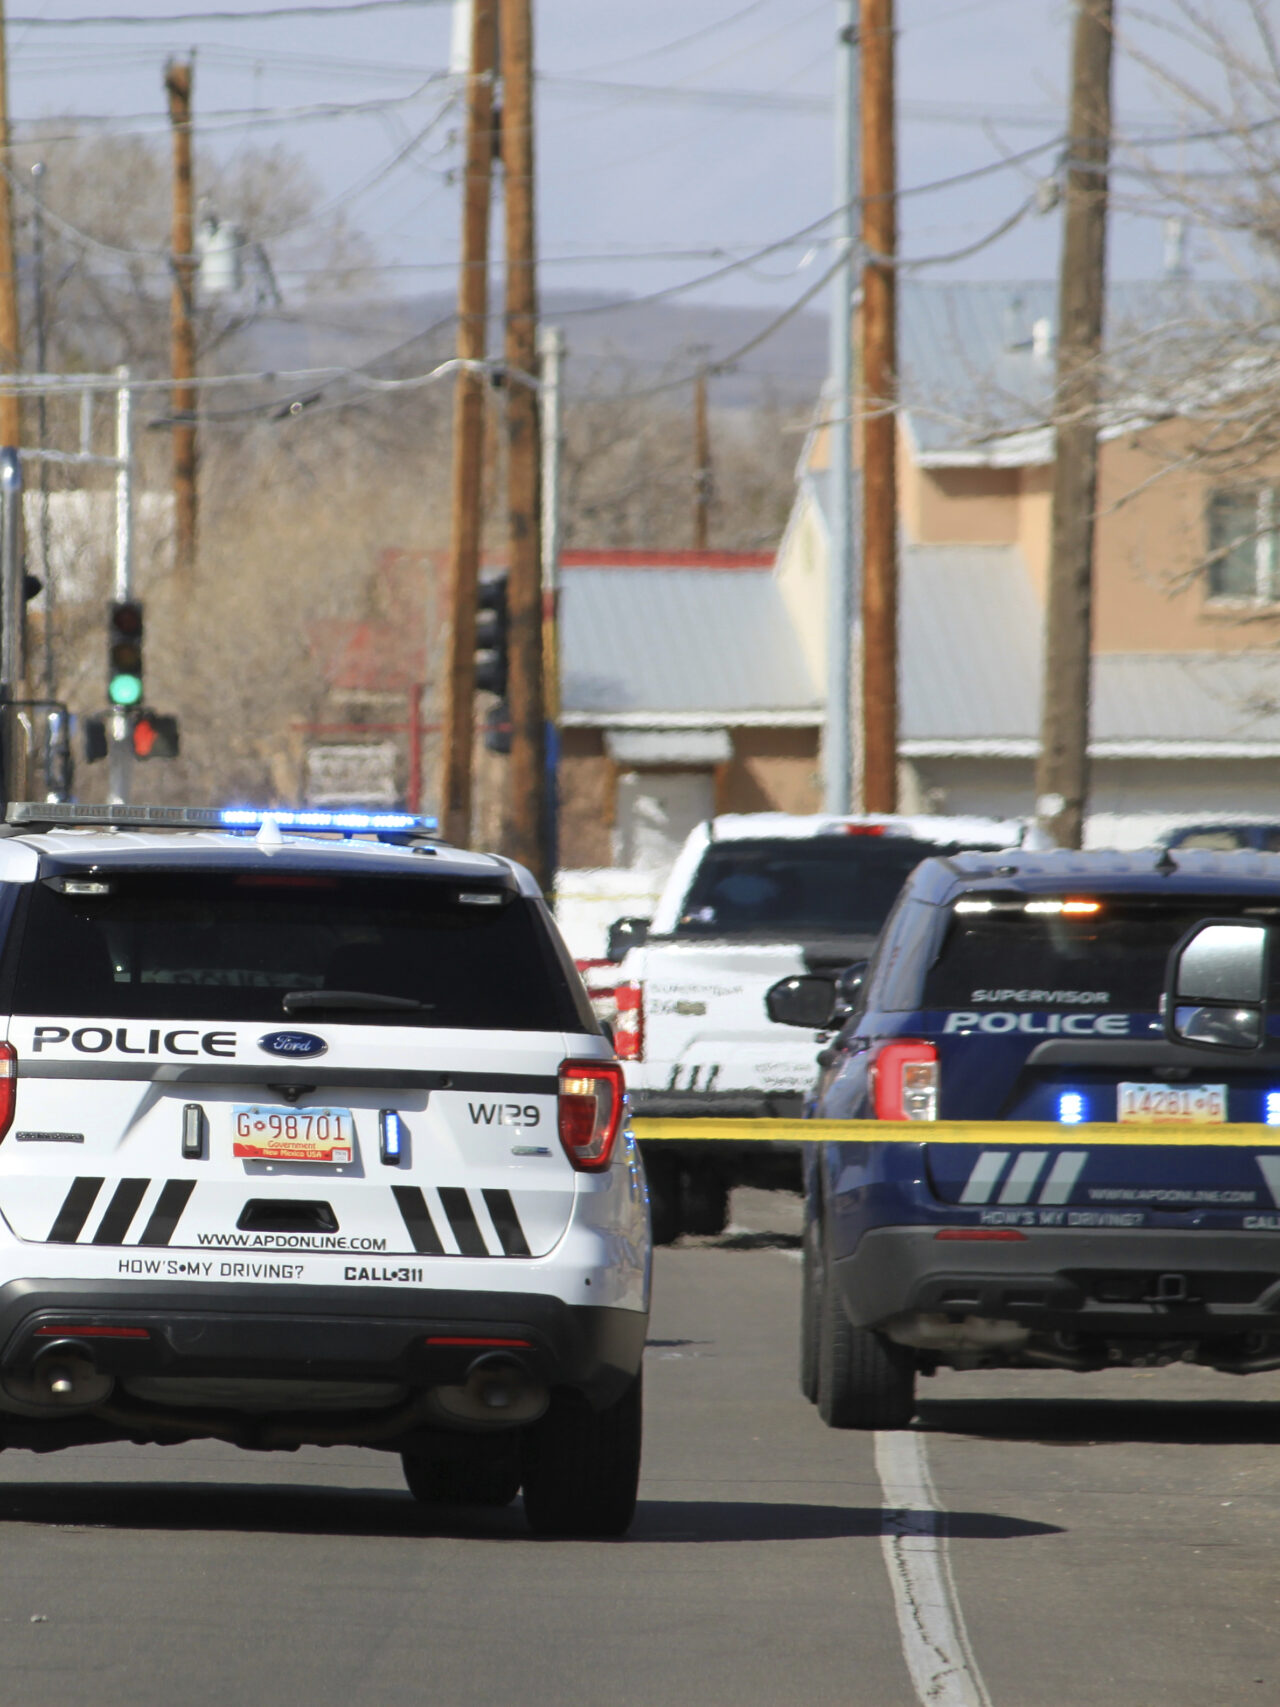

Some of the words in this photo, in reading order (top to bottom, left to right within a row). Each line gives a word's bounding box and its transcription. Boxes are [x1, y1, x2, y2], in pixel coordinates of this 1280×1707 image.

[971, 989, 1110, 1004] SUPERVISOR
[942, 1011, 1130, 1034] POLICE
[32, 1026, 237, 1057] POLICE
[272, 1033, 313, 1052] Ford
[263, 1148, 279, 1156] New
[280, 1149, 305, 1157] Mexico
[268, 1140, 317, 1149] Government
[980, 1211, 1035, 1225] HOW'S
[1039, 1212, 1064, 1225] MY
[1068, 1212, 1146, 1226] DRIVING?
[197, 1233, 387, 1250] WWW.APDONLINE.COM
[118, 1259, 178, 1274] HOW'S
[187, 1261, 213, 1276] MY
[220, 1263, 304, 1278] DRIVING?
[344, 1266, 392, 1281] CALL
[398, 1268, 423, 1282] 311
